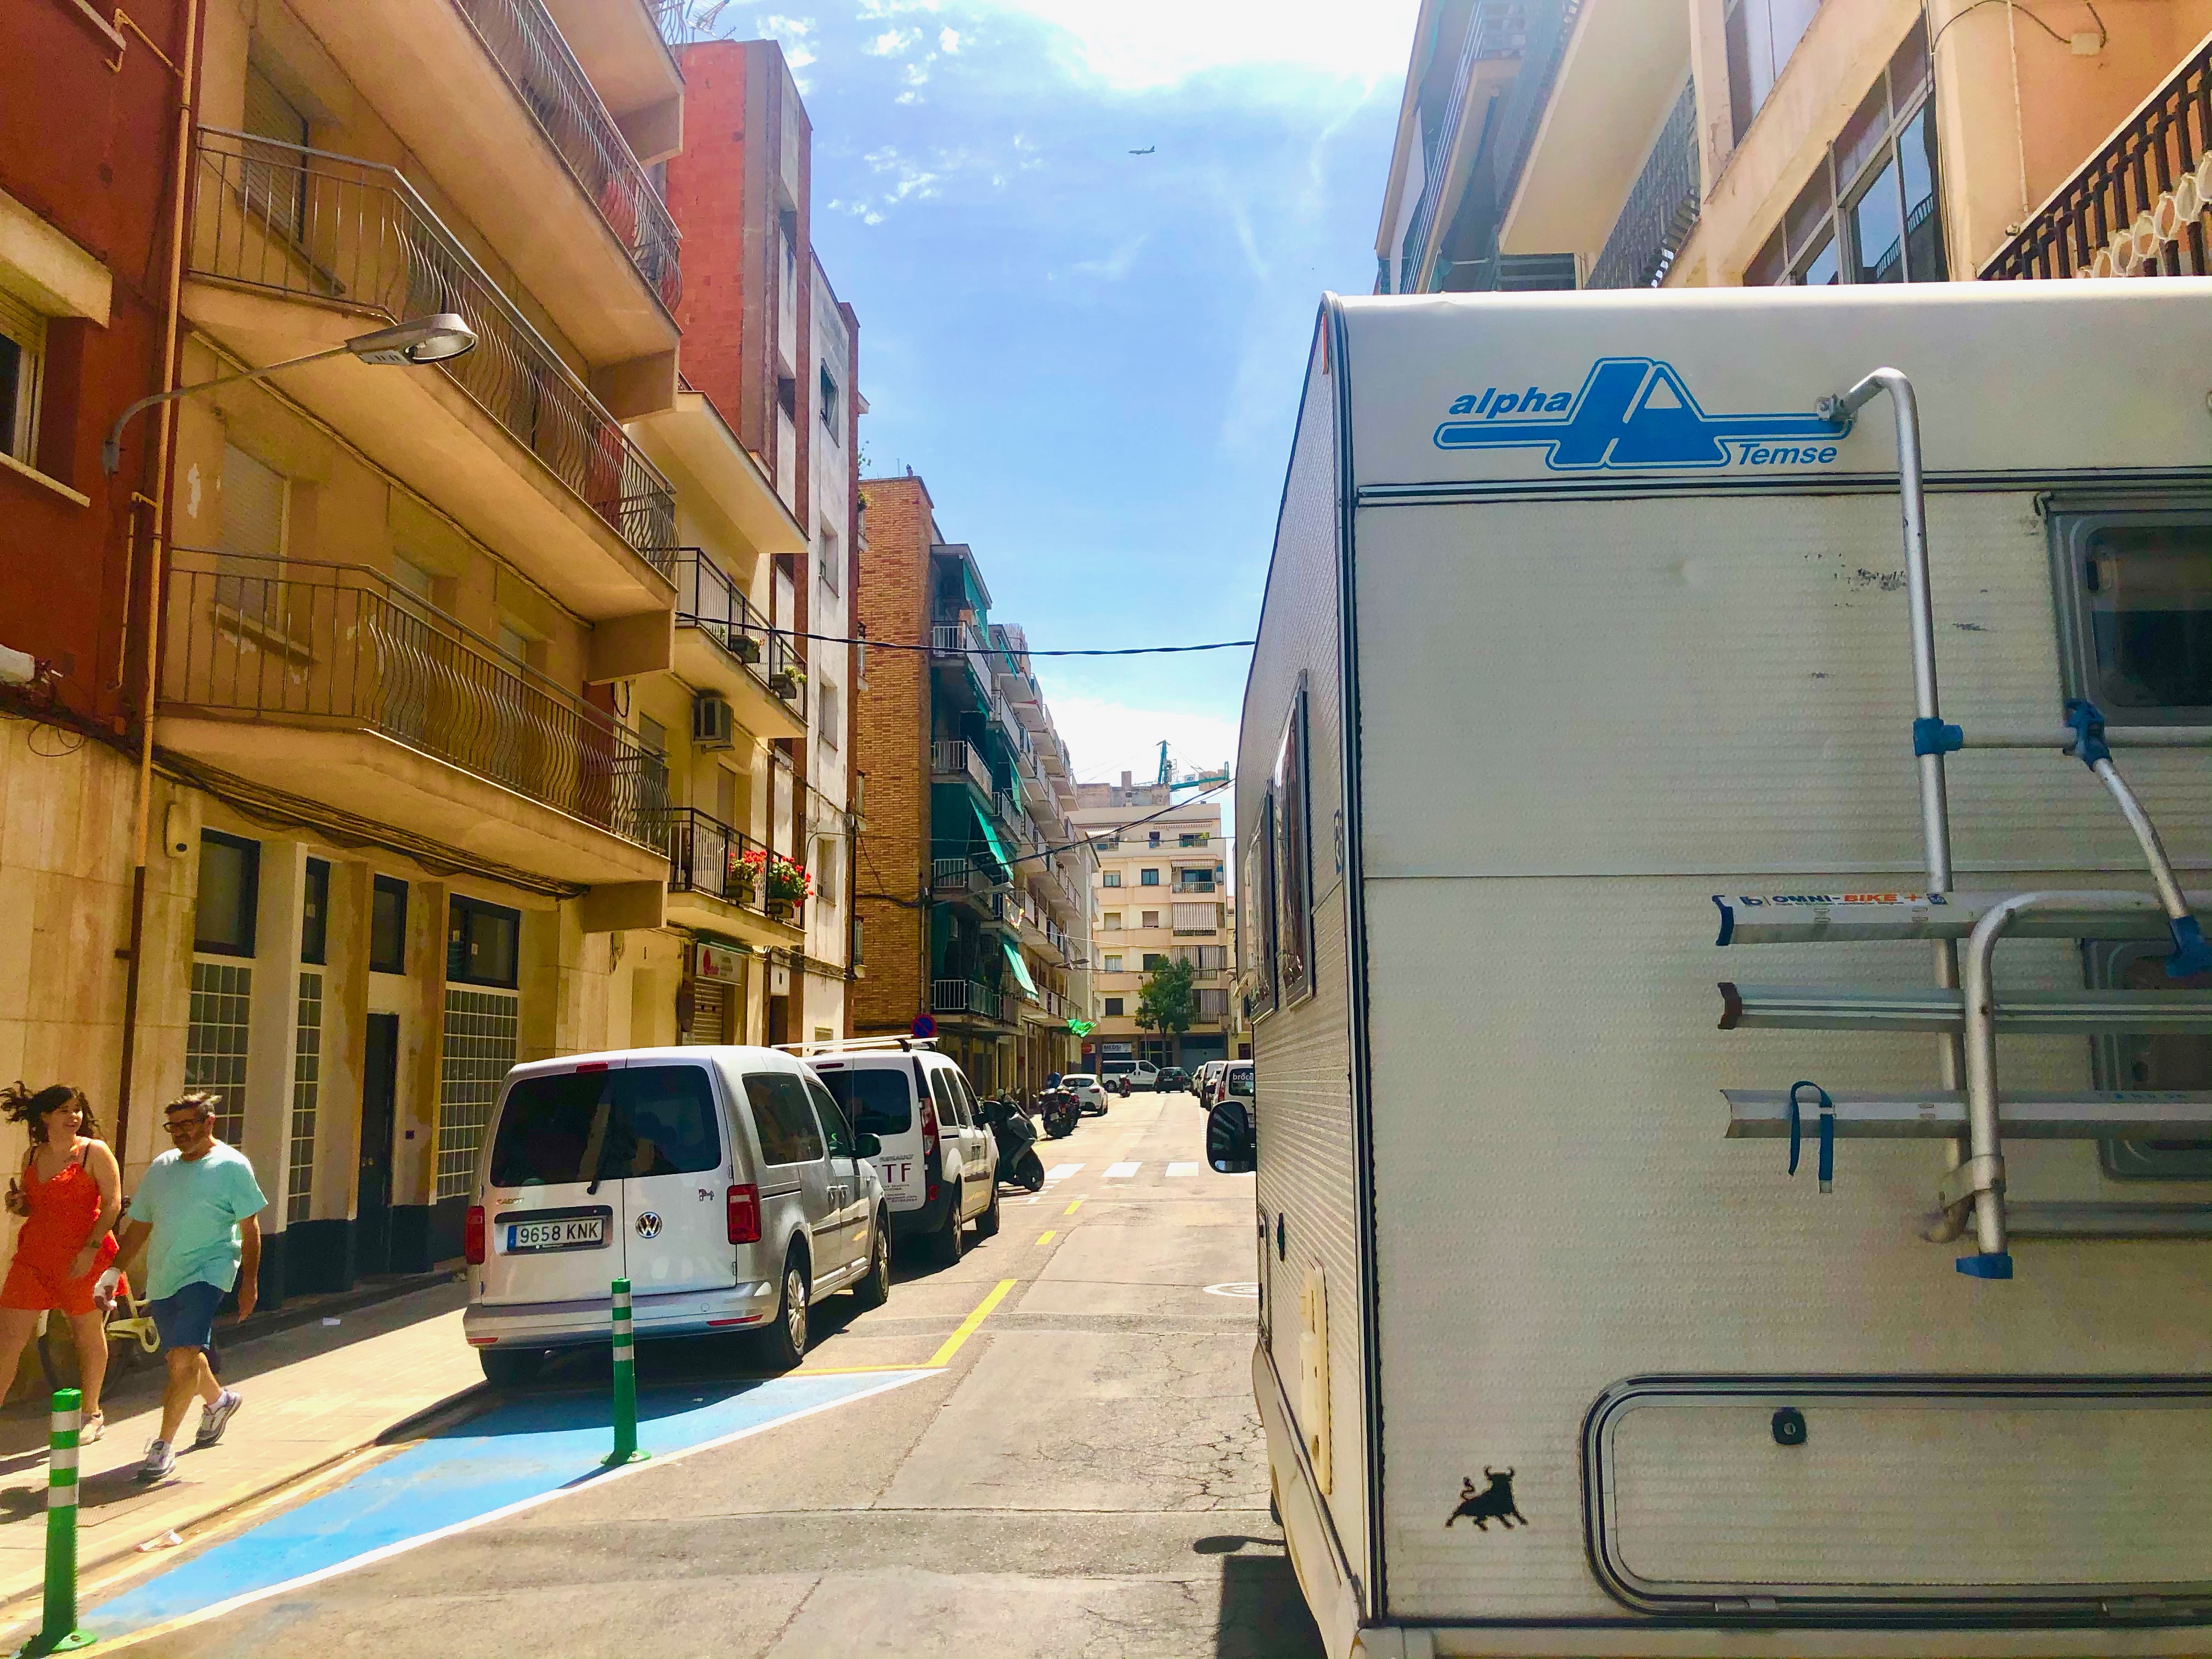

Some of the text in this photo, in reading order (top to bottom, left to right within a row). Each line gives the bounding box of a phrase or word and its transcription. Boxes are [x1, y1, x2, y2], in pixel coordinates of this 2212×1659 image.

[1449, 381, 1572, 419] alpha
[1739, 437, 1837, 465] Temse
[872, 1163, 912, 1183] TF
[520, 1221, 599, 1244] 9658 KNK
